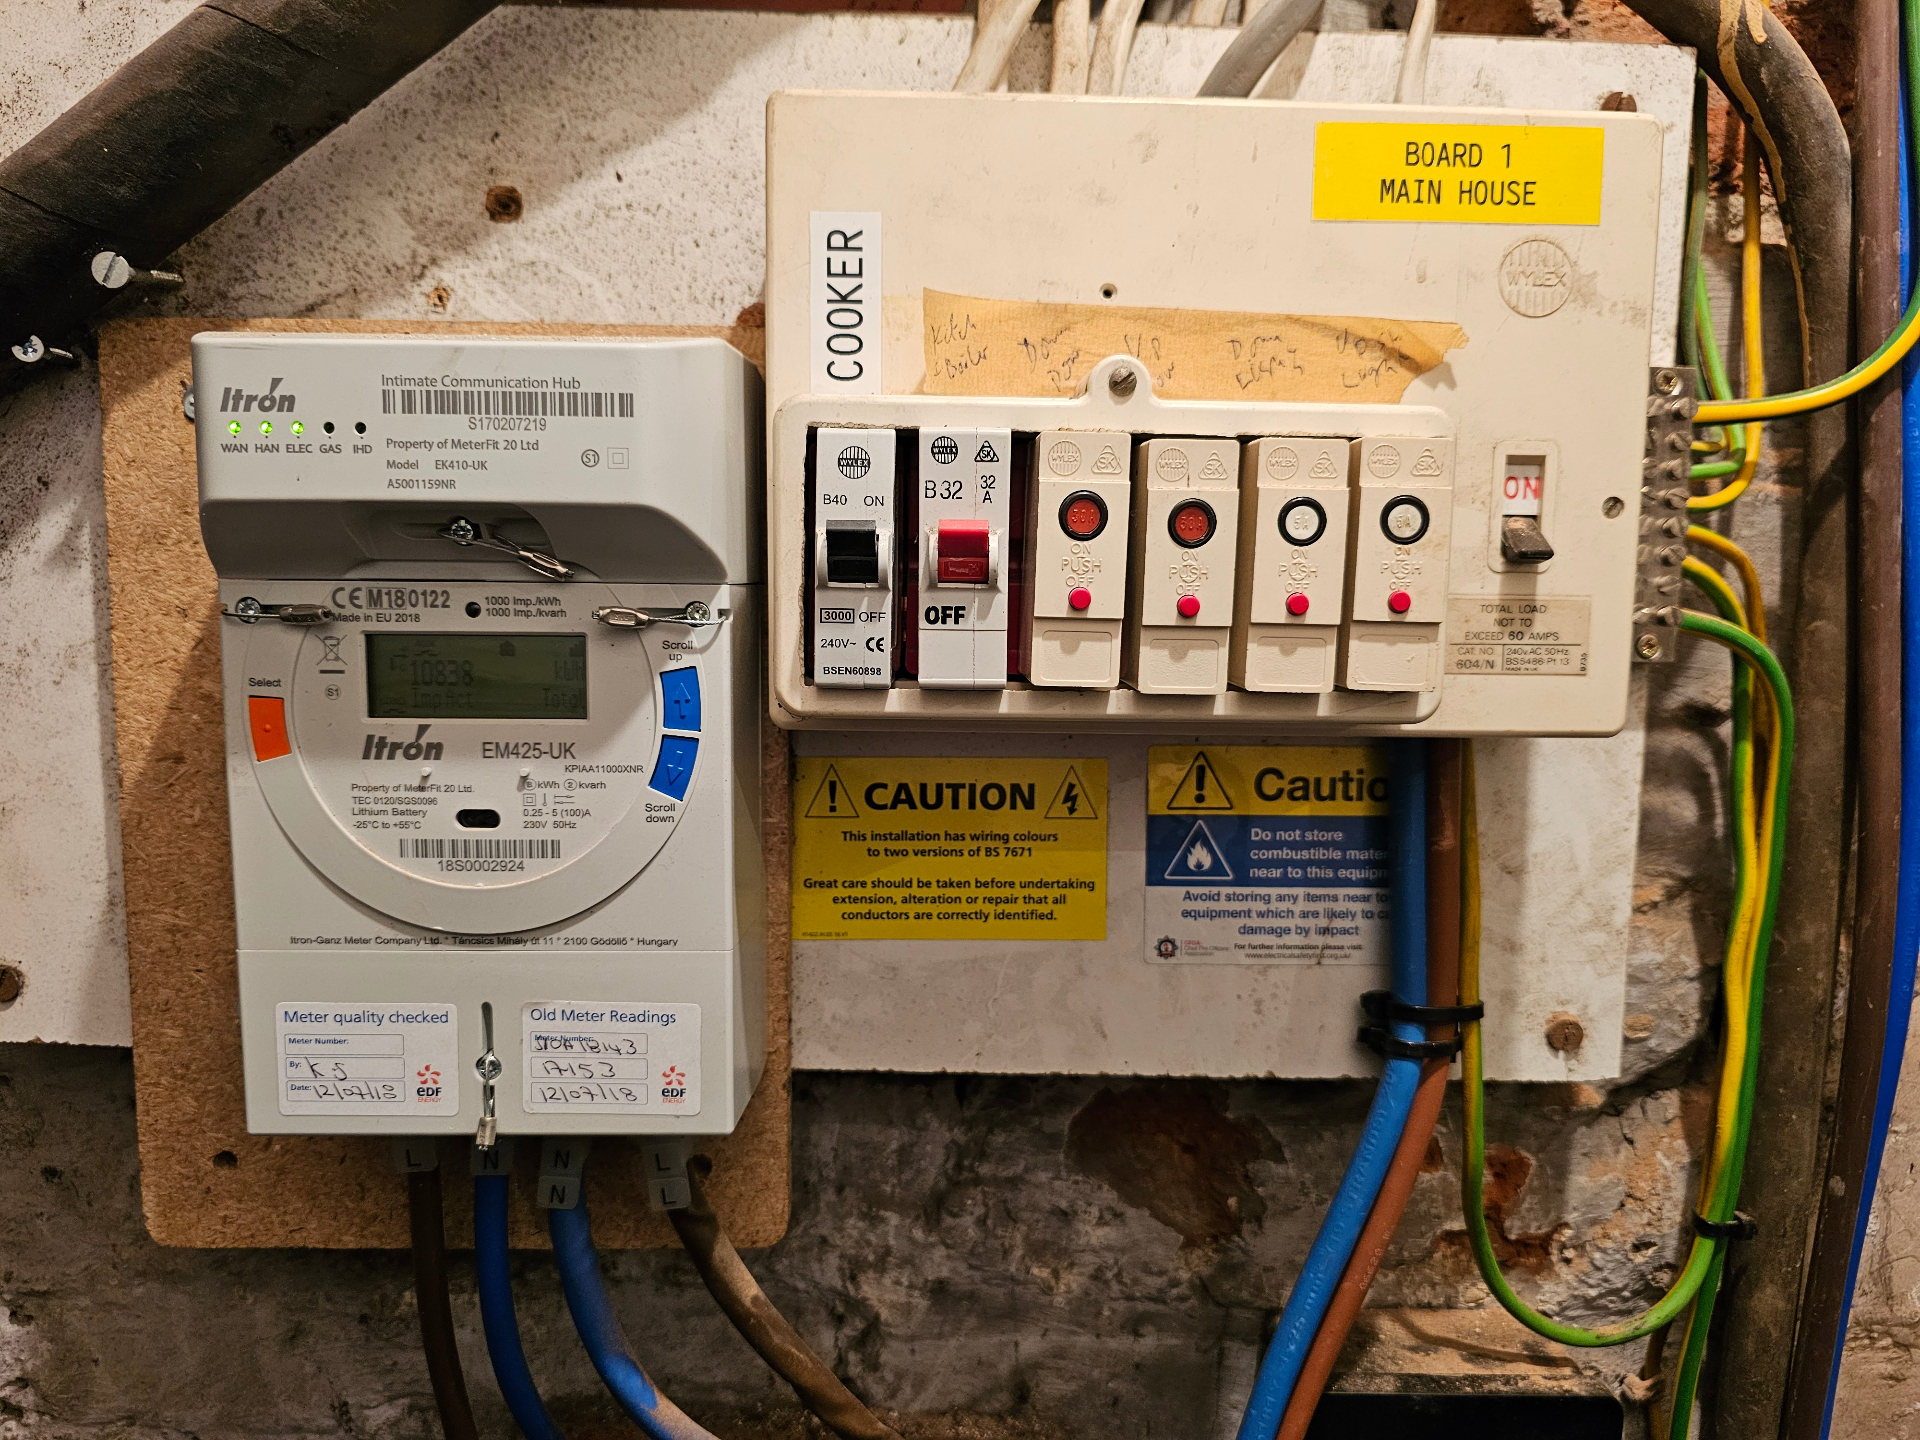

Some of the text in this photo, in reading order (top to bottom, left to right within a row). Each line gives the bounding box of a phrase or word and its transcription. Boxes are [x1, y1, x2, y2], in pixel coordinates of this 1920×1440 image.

[1405, 141, 1512, 168] BOARD 1
[1379, 178, 1537, 207] MAIN HOUSE
[1506, 270, 1567, 287] WYLEX
[826, 229, 864, 382] COOKER
[381, 374, 581, 391] Intimate Communication Hub
[468, 417, 547, 432] S170207219
[221, 443, 373, 454] WAN HAN ELEC GAS IHD
[386, 438, 540, 452] Property of MeterFit 20 Ltd
[386, 458, 488, 471] Model EK410-UK
[838, 458, 870, 466] WYLEX
[387, 478, 456, 490] A5001159NR
[1503, 476, 1541, 500] ON
[823, 494, 884, 507] B40 ON
[1061, 558, 1102, 574] PUSH
[1278, 563, 1318, 578] PUSH
[1380, 560, 1422, 575] PUSH
[1169, 565, 1209, 580] PUSH
[1065, 575, 1095, 588] OFF
[1285, 581, 1310, 593] OFF
[1389, 579, 1412, 591] OFF
[1176, 584, 1201, 596] OFF
[485, 596, 561, 608] 1000 Imp./kWh
[486, 608, 567, 619] 1000 Imp./kvarh
[924, 605, 966, 625] OFF
[1480, 604, 1547, 614] TOTAL LOAD
[332, 612, 421, 623] Made in EU 2018
[823, 610, 886, 623] 3000 OFF
[1493, 617, 1533, 628] NOT TO
[1464, 630, 1560, 642] EXCEED 60 AMPS
[662, 640, 693, 651] Scroll
[1457, 646, 1475, 656] CAT
[669, 652, 683, 662] up
[1456, 658, 1495, 670] 604/N
[823, 666, 882, 676] BSEN60898
[249, 677, 281, 688] Select
[482, 741, 576, 760] EM425-UK
[564, 764, 644, 774] KPIAA11000XNR
[351, 783, 475, 794] Property of MeterFit 20 Ltd.
[352, 796, 372, 806] TEC
[864, 781, 1036, 811] CAUTION
[352, 807, 428, 818] Lithium Battery
[523, 808, 591, 819] 0.25 (100)A
[645, 803, 676, 813] Scroll
[523, 820, 577, 829] 230V 50Hz
[645, 814, 675, 824] down
[841, 830, 1059, 845] This installation has wiring colours
[1250, 828, 1344, 842] Do not store
[867, 846, 1033, 858] to two versions of BS 7671
[1249, 848, 1342, 861] combustible
[438, 859, 525, 872] 18S0002924
[1249, 866, 1334, 879] near to this
[803, 878, 1096, 893] Great care should be taken before undertaking
[832, 894, 1067, 908] extension, alteration or repair that all
[1182, 890, 1372, 906] Avoid storing any items near
[841, 909, 1057, 924] conductors are correctly identified.
[1181, 907, 1374, 922] equipment which are likely to
[1237, 923, 1359, 938] damage by impact
[290, 936, 679, 948] Itron-Ganz Meter Company Mihály 2100 Hungary
[1275, 942, 1319, 951] information
[284, 1010, 449, 1027] Meter quality checked
[530, 1008, 676, 1027] Old Meter Readings
[288, 1037, 349, 1045] Meter Number:
[289, 1061, 302, 1069] By:
[290, 1083, 312, 1091] Date:
